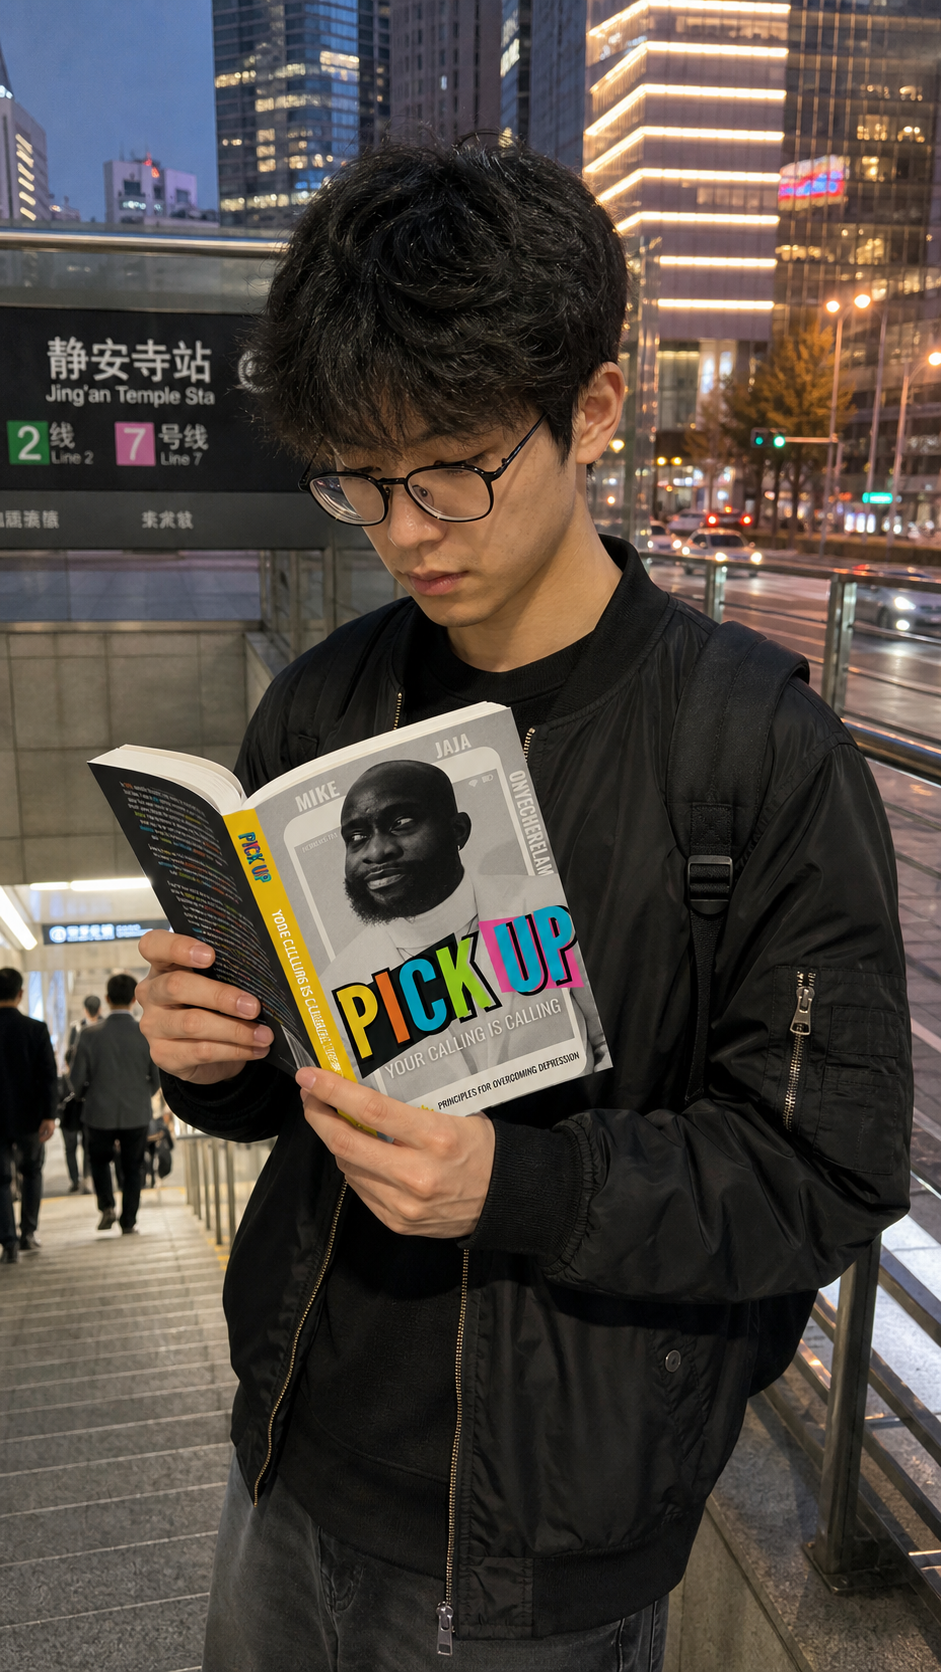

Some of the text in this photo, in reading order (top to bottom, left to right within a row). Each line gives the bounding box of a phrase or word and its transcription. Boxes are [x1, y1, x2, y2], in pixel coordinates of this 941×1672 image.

[47, 336, 212, 383] 静安寺站
[45, 384, 215, 408] Jing'an Temple Sta
[17, 425, 42, 460] 2
[51, 451, 94, 464] Line 2
[124, 423, 209, 461] 7 号线
[160, 452, 203, 466] Line 7
[295, 733, 472, 812] MIKE JAJA
[238, 832, 272, 883] PICK UP
[333, 932, 501, 1062] PICK
[494, 905, 577, 996] UP
[385, 998, 562, 1079] YOUR CALLING IS CALLING
[478, 1083, 493, 1095] FOR
[492, 1066, 538, 1089] OVERCOMING
